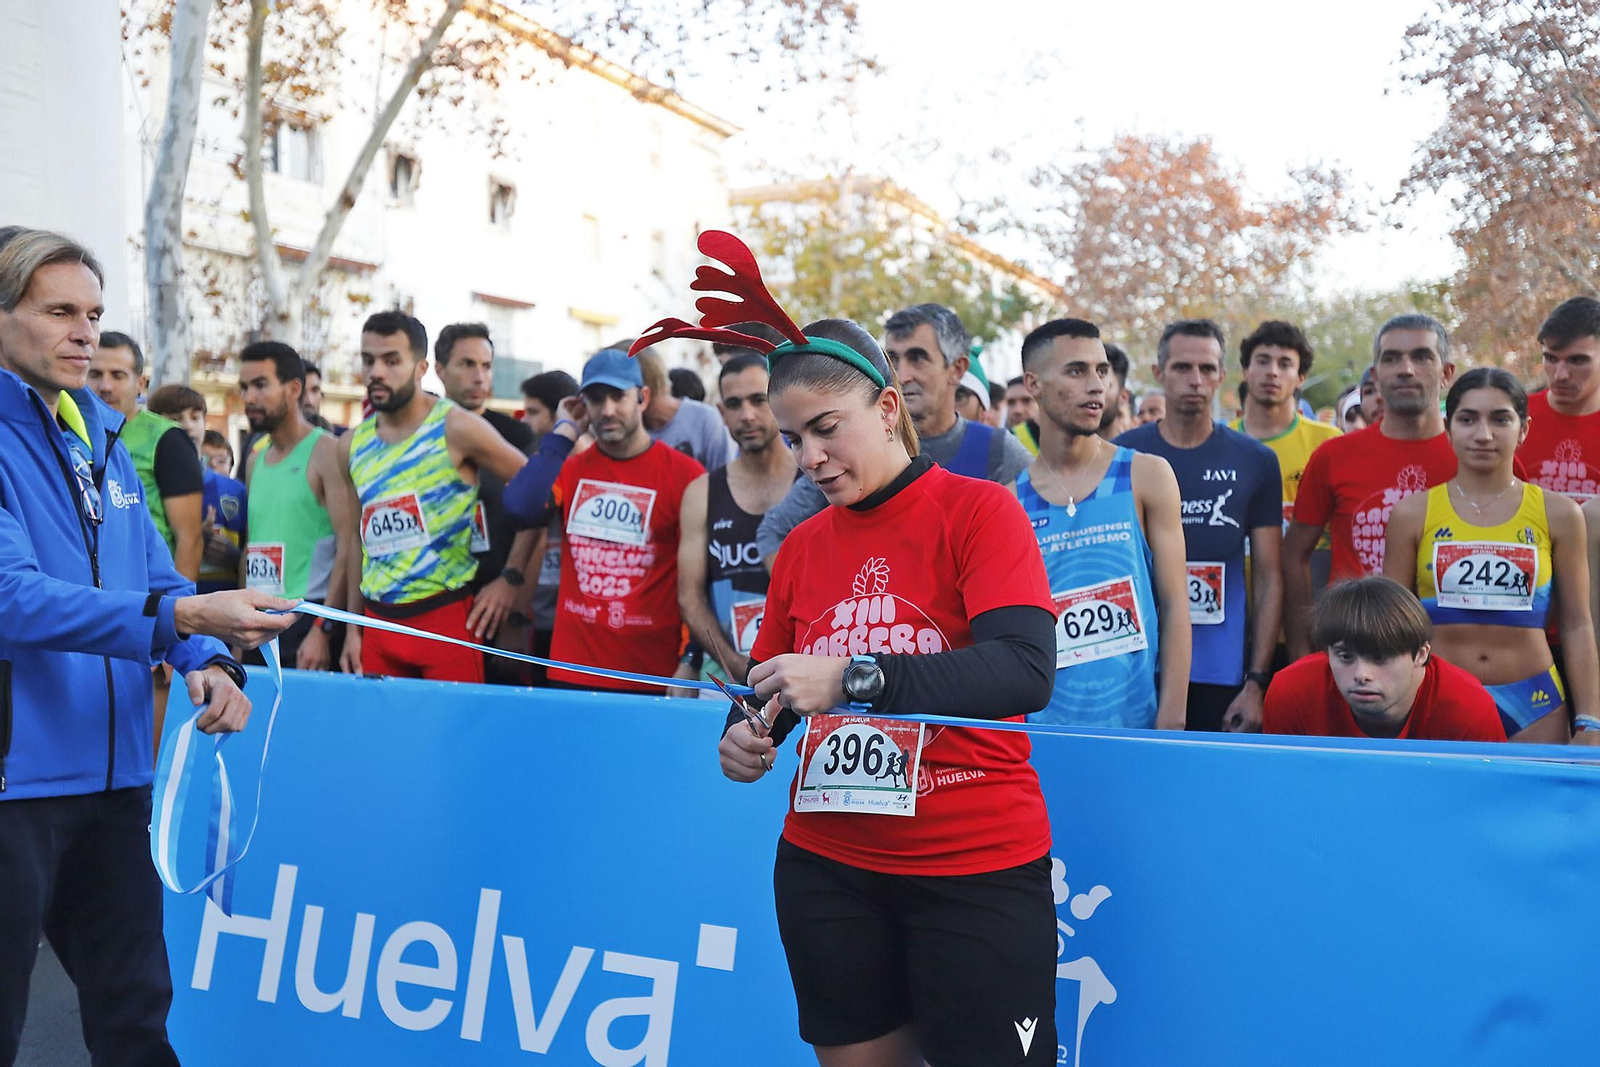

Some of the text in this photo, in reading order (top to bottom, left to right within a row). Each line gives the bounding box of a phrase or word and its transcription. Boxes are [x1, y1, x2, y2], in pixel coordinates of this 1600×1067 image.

[1203, 469, 1236, 481] JAVI
[1540, 461, 1586, 479] XIII
[591, 498, 630, 522] 300
[371, 511, 404, 536] 645
[1062, 522, 1132, 539] ONUBENSE
[1051, 531, 1131, 552] ATLETISMO
[577, 572, 631, 597] 2023
[1458, 560, 1511, 587] 242
[830, 596, 896, 630] XIII
[1064, 604, 1114, 639] 629
[824, 733, 885, 776] 396
[937, 770, 986, 786] HUELVA
[191, 863, 679, 1067] Huelva
